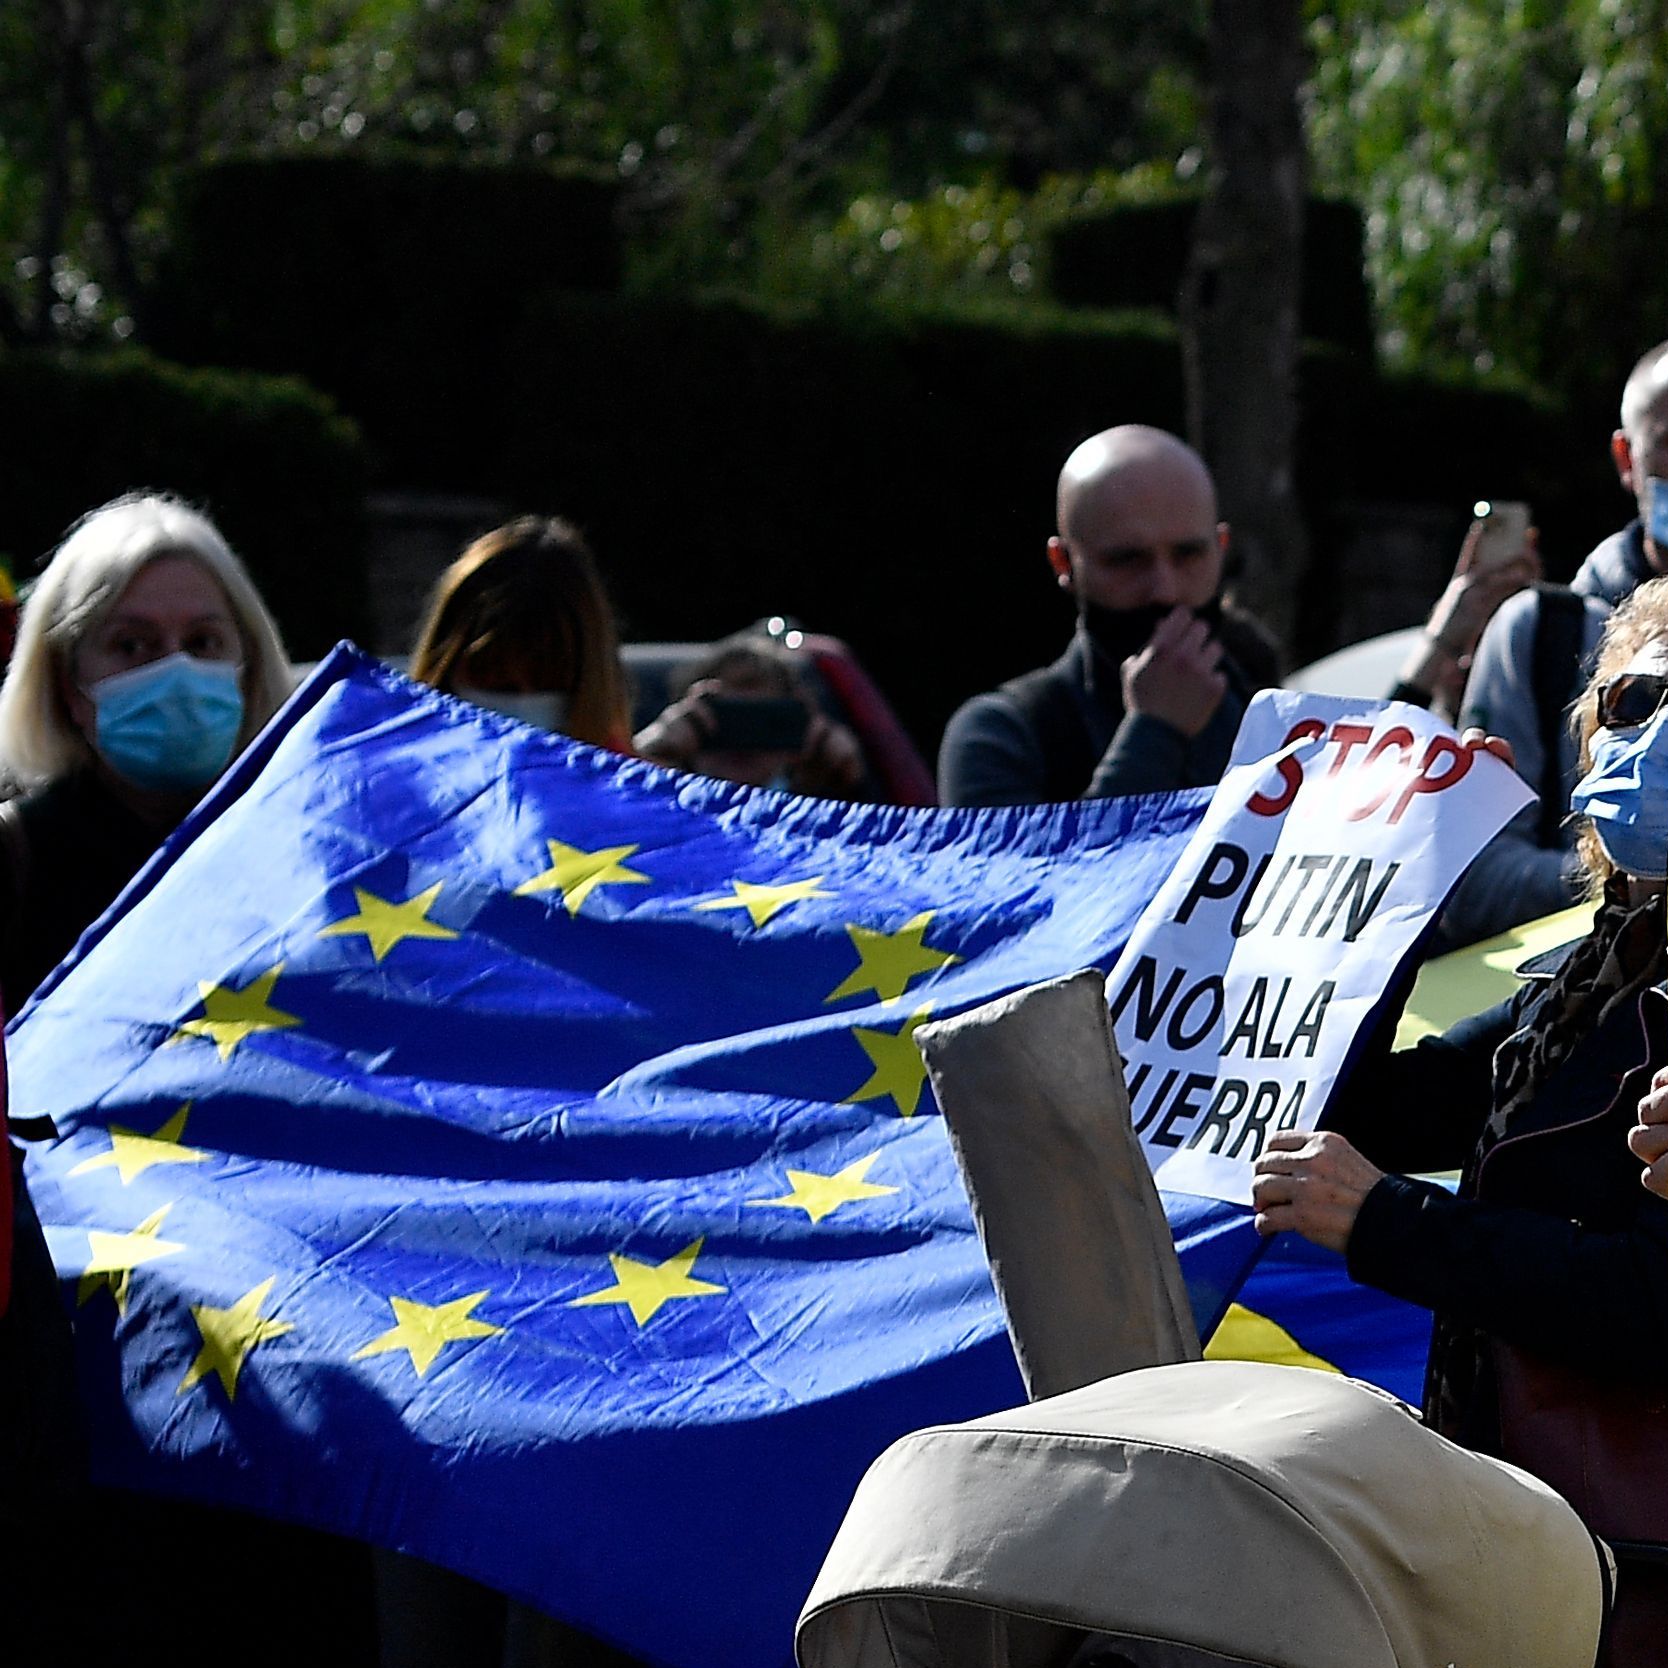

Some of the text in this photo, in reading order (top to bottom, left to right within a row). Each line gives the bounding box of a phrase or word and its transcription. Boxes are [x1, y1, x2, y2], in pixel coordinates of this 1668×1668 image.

[1246, 718, 1473, 824] STOP
[1173, 842, 1400, 942] PUTIN
[1110, 957, 1224, 1050] NO
[1122, 1062, 1306, 1161] UERRA
